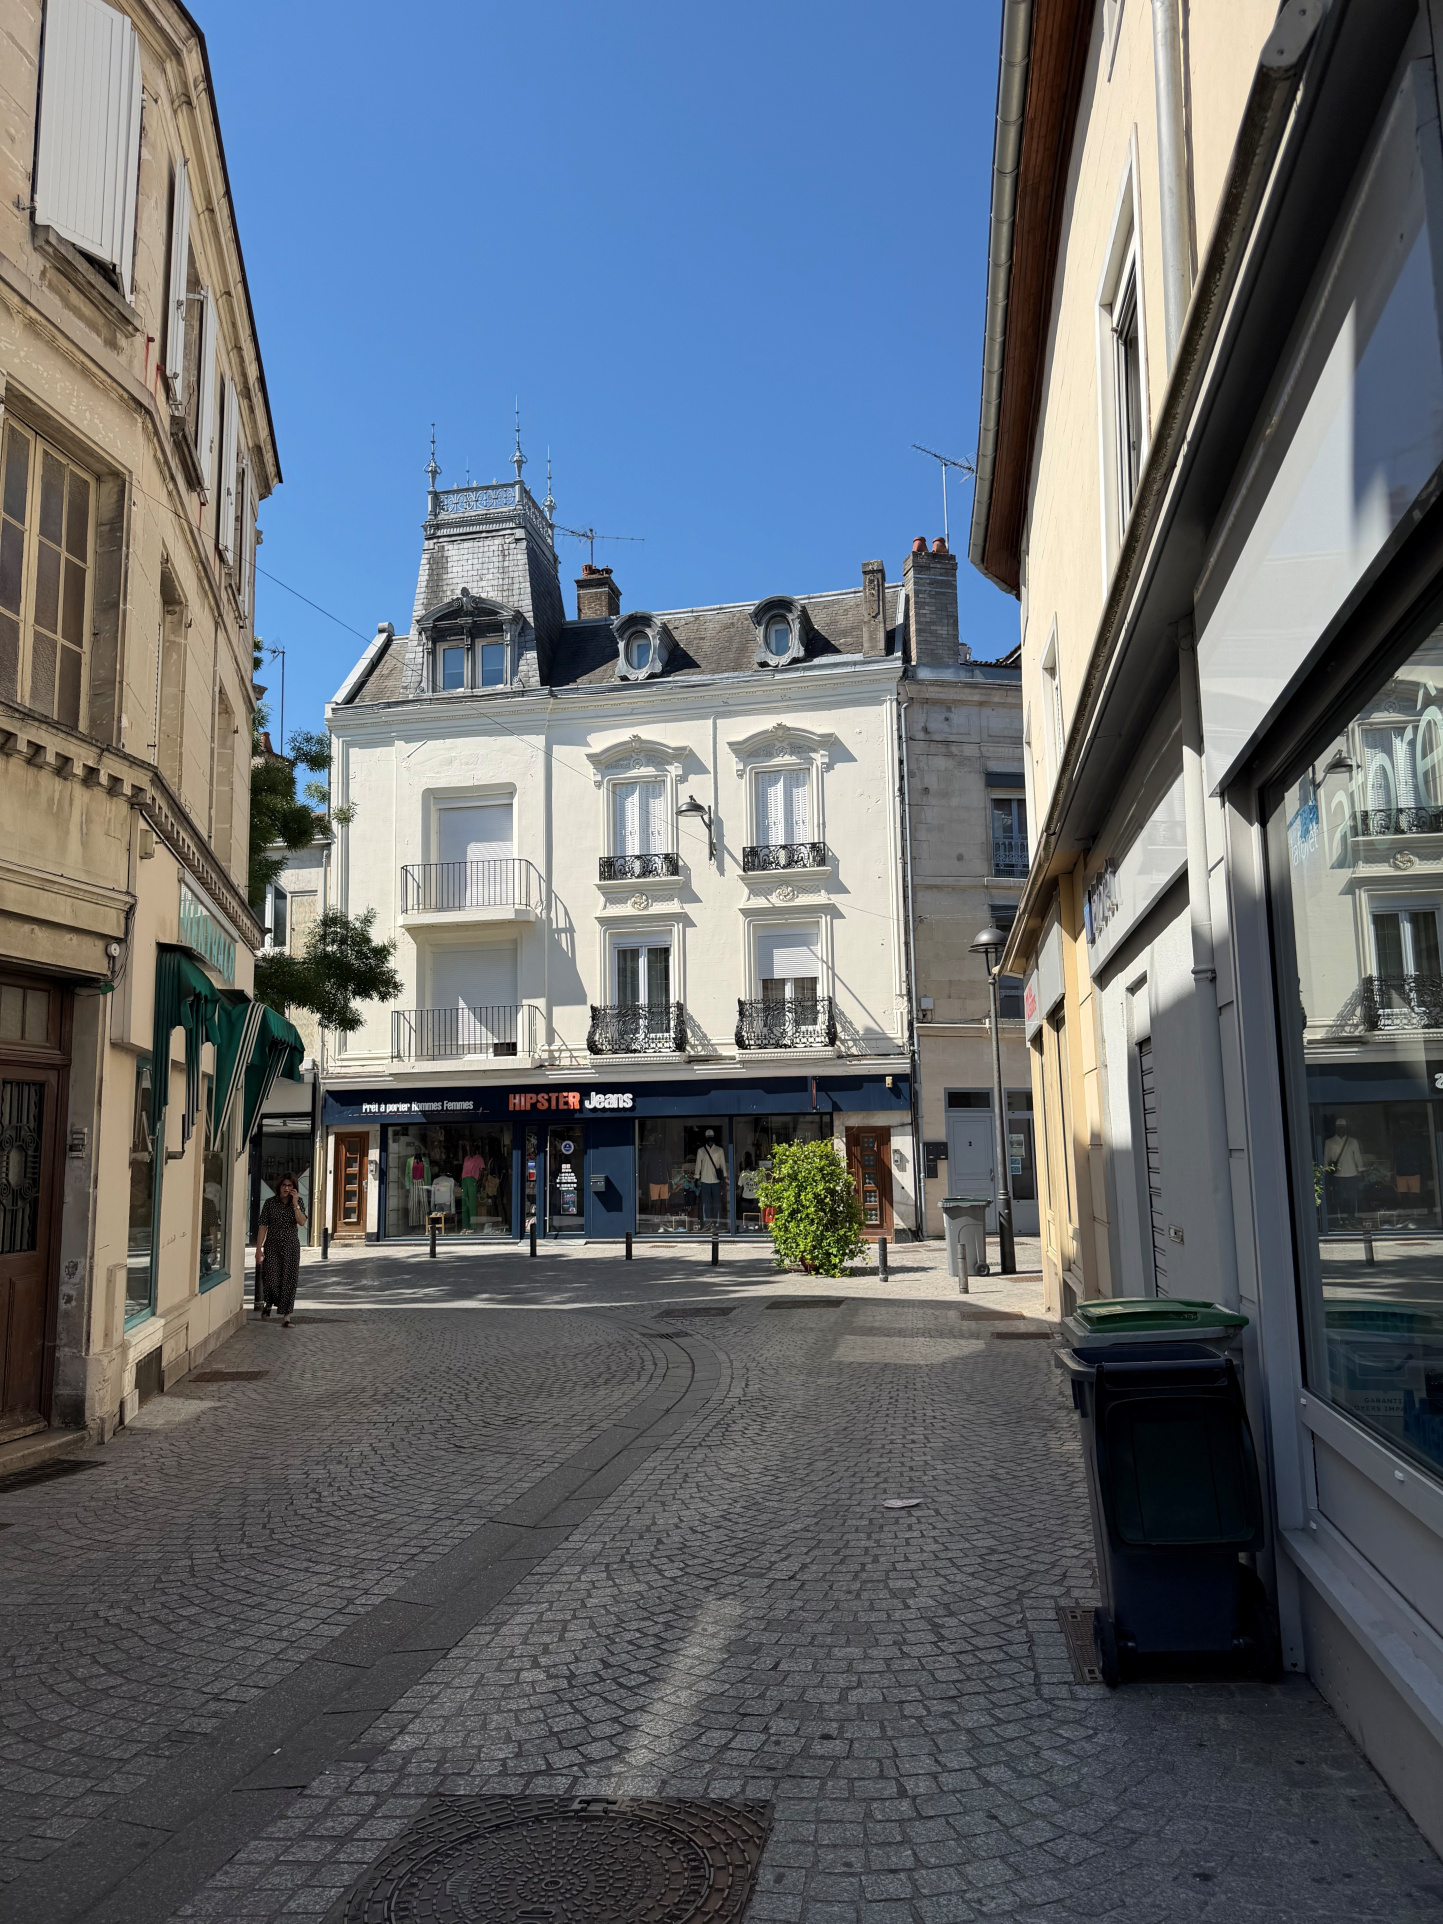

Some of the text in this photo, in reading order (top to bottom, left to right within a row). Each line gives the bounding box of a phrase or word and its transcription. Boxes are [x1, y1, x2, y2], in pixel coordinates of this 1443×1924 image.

[362, 1100, 474, 1114] Prêt à porter Hommes Femmes
[508, 1092, 634, 1111] HIPSTER Jeans
